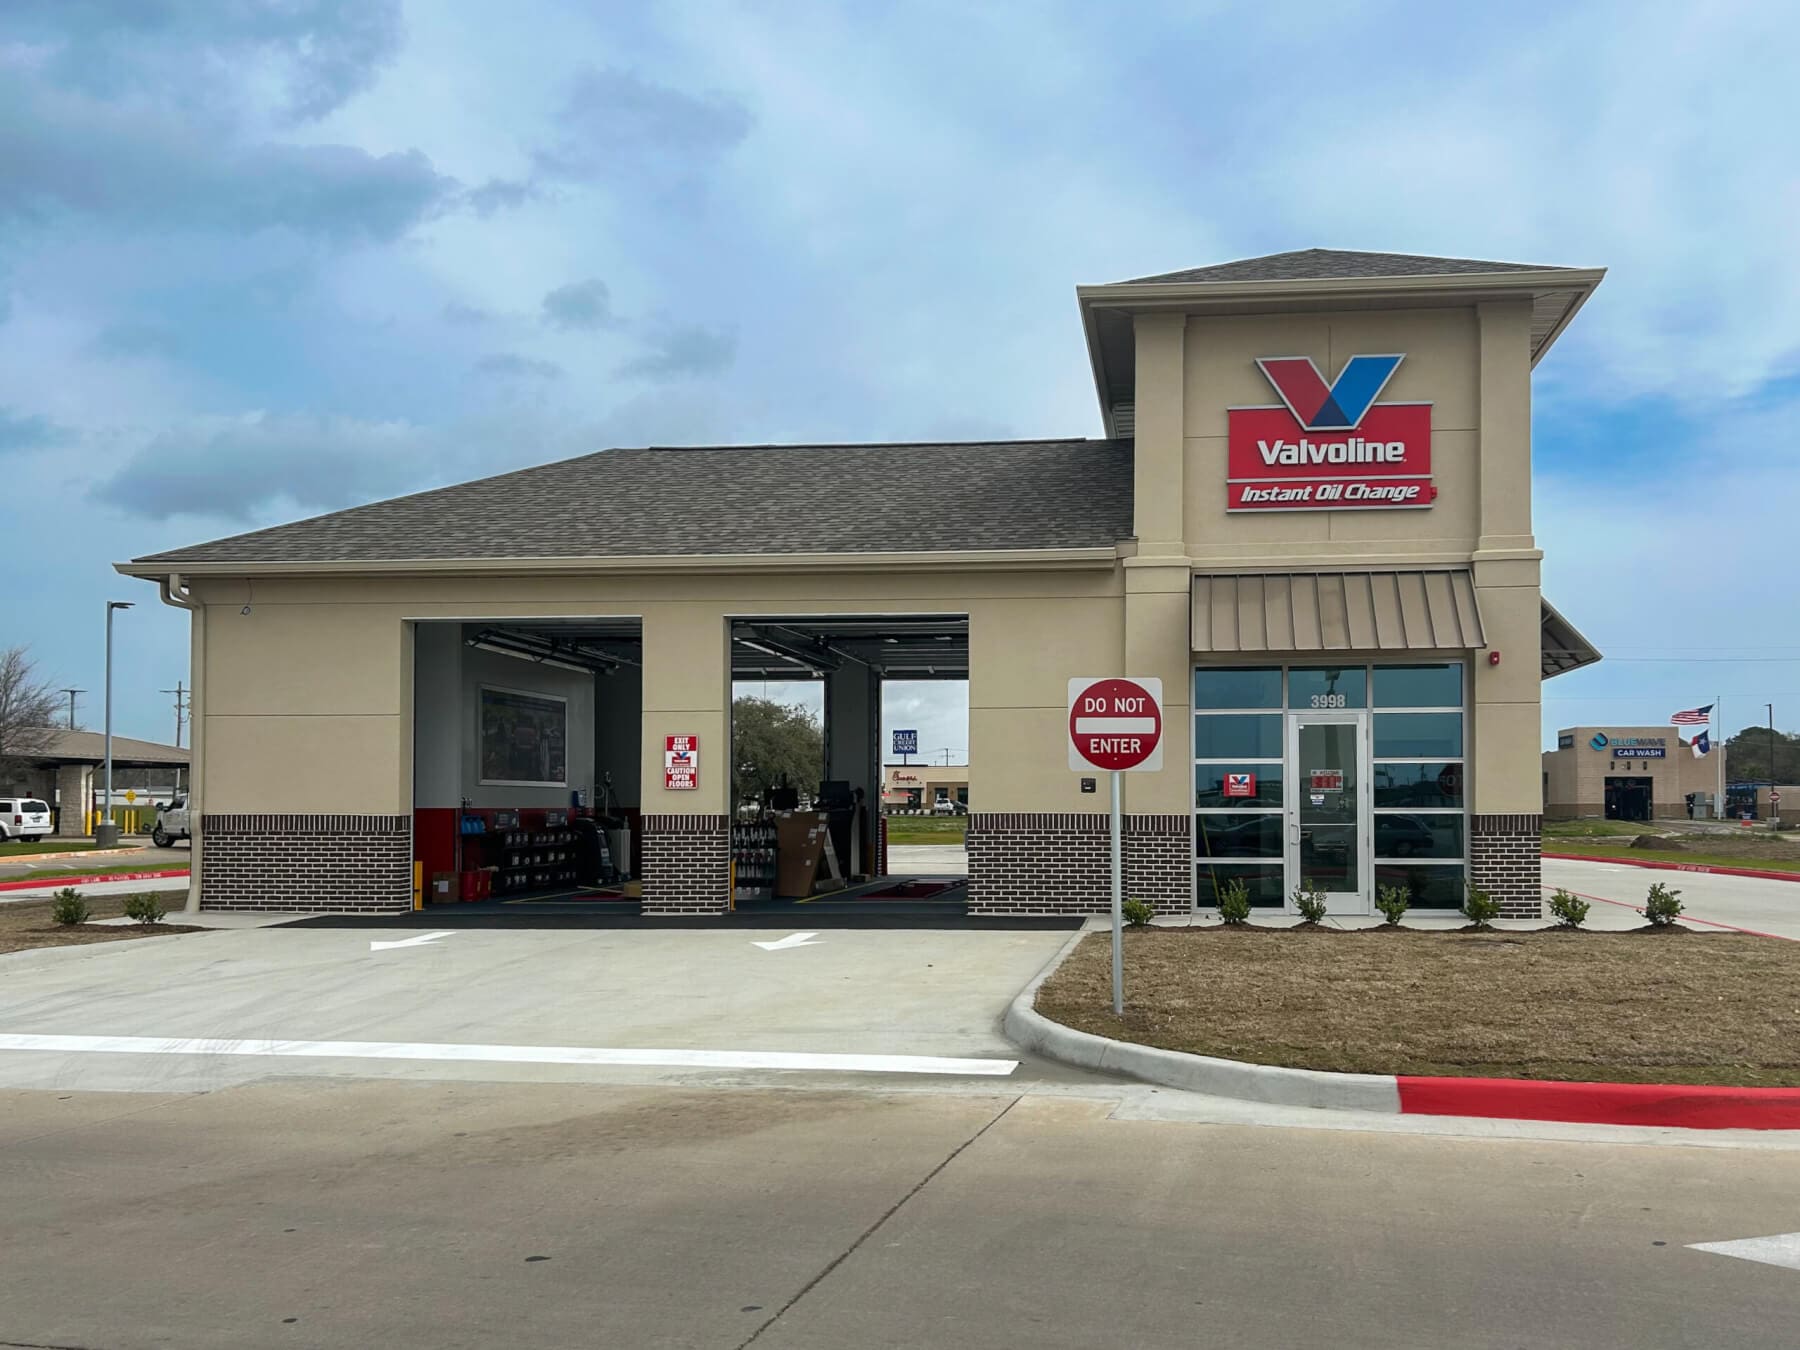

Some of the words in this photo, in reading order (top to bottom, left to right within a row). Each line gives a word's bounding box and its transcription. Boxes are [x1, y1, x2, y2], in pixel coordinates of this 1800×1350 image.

[1257, 437, 1405, 465] Valvoline
[1240, 485, 1313, 502] Instant
[1315, 484, 1343, 500] Oil
[1344, 483, 1420, 502] Change
[1084, 697, 1107, 713] DO
[1114, 697, 1146, 713] NOT
[1311, 694, 1345, 708] 3998
[1090, 738, 1141, 754] ENTER
